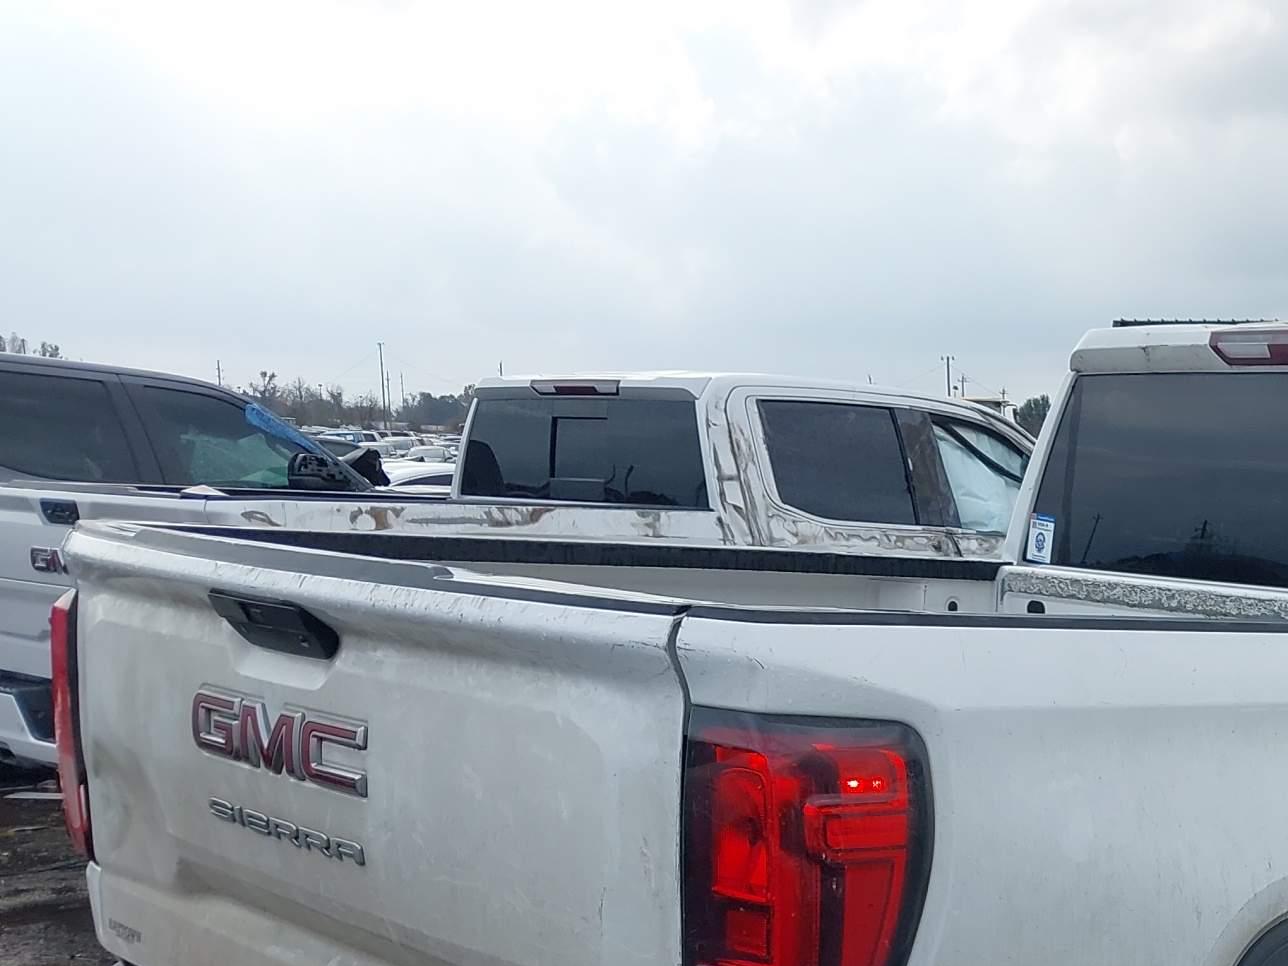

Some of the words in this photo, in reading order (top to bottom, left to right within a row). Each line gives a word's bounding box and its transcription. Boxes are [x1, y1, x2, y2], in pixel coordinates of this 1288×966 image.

[30, 547, 68, 574] GM
[191, 689, 369, 799] GMC
[208, 797, 366, 866] SIERRA
